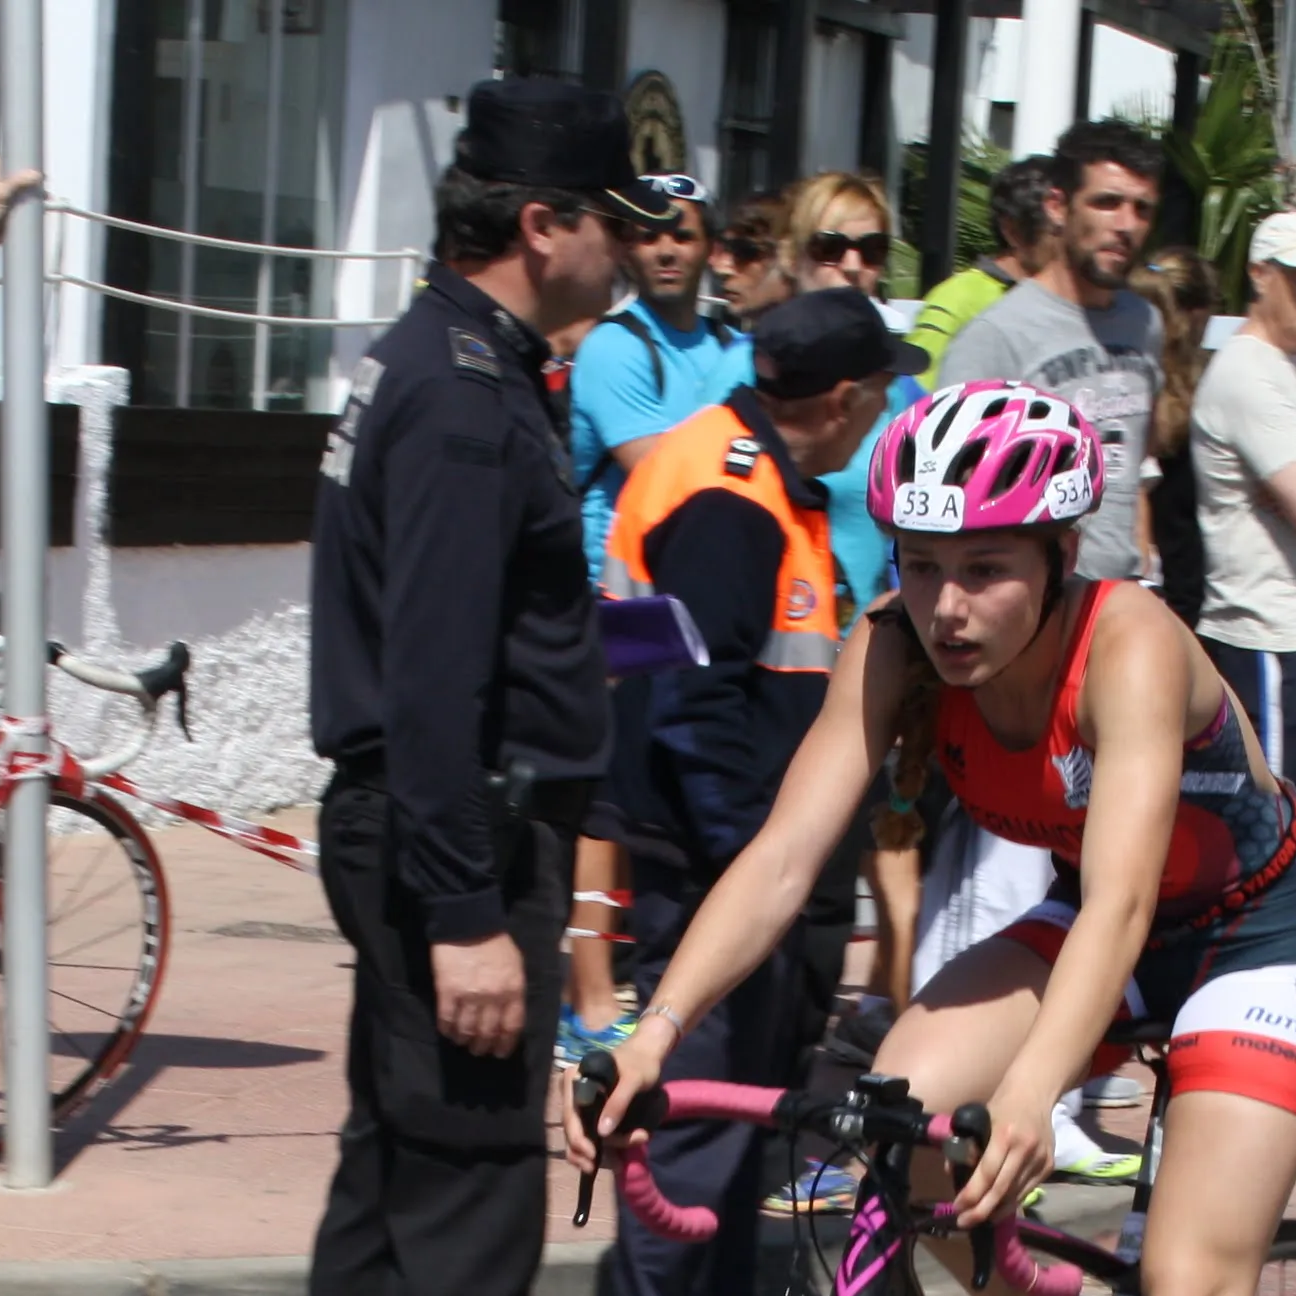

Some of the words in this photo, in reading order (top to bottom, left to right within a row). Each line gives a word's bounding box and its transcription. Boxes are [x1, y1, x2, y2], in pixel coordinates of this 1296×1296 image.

[1054, 478, 1078, 505] 53
[1081, 472, 1092, 501] A
[903, 490, 930, 517] 53
[941, 493, 959, 518] A
